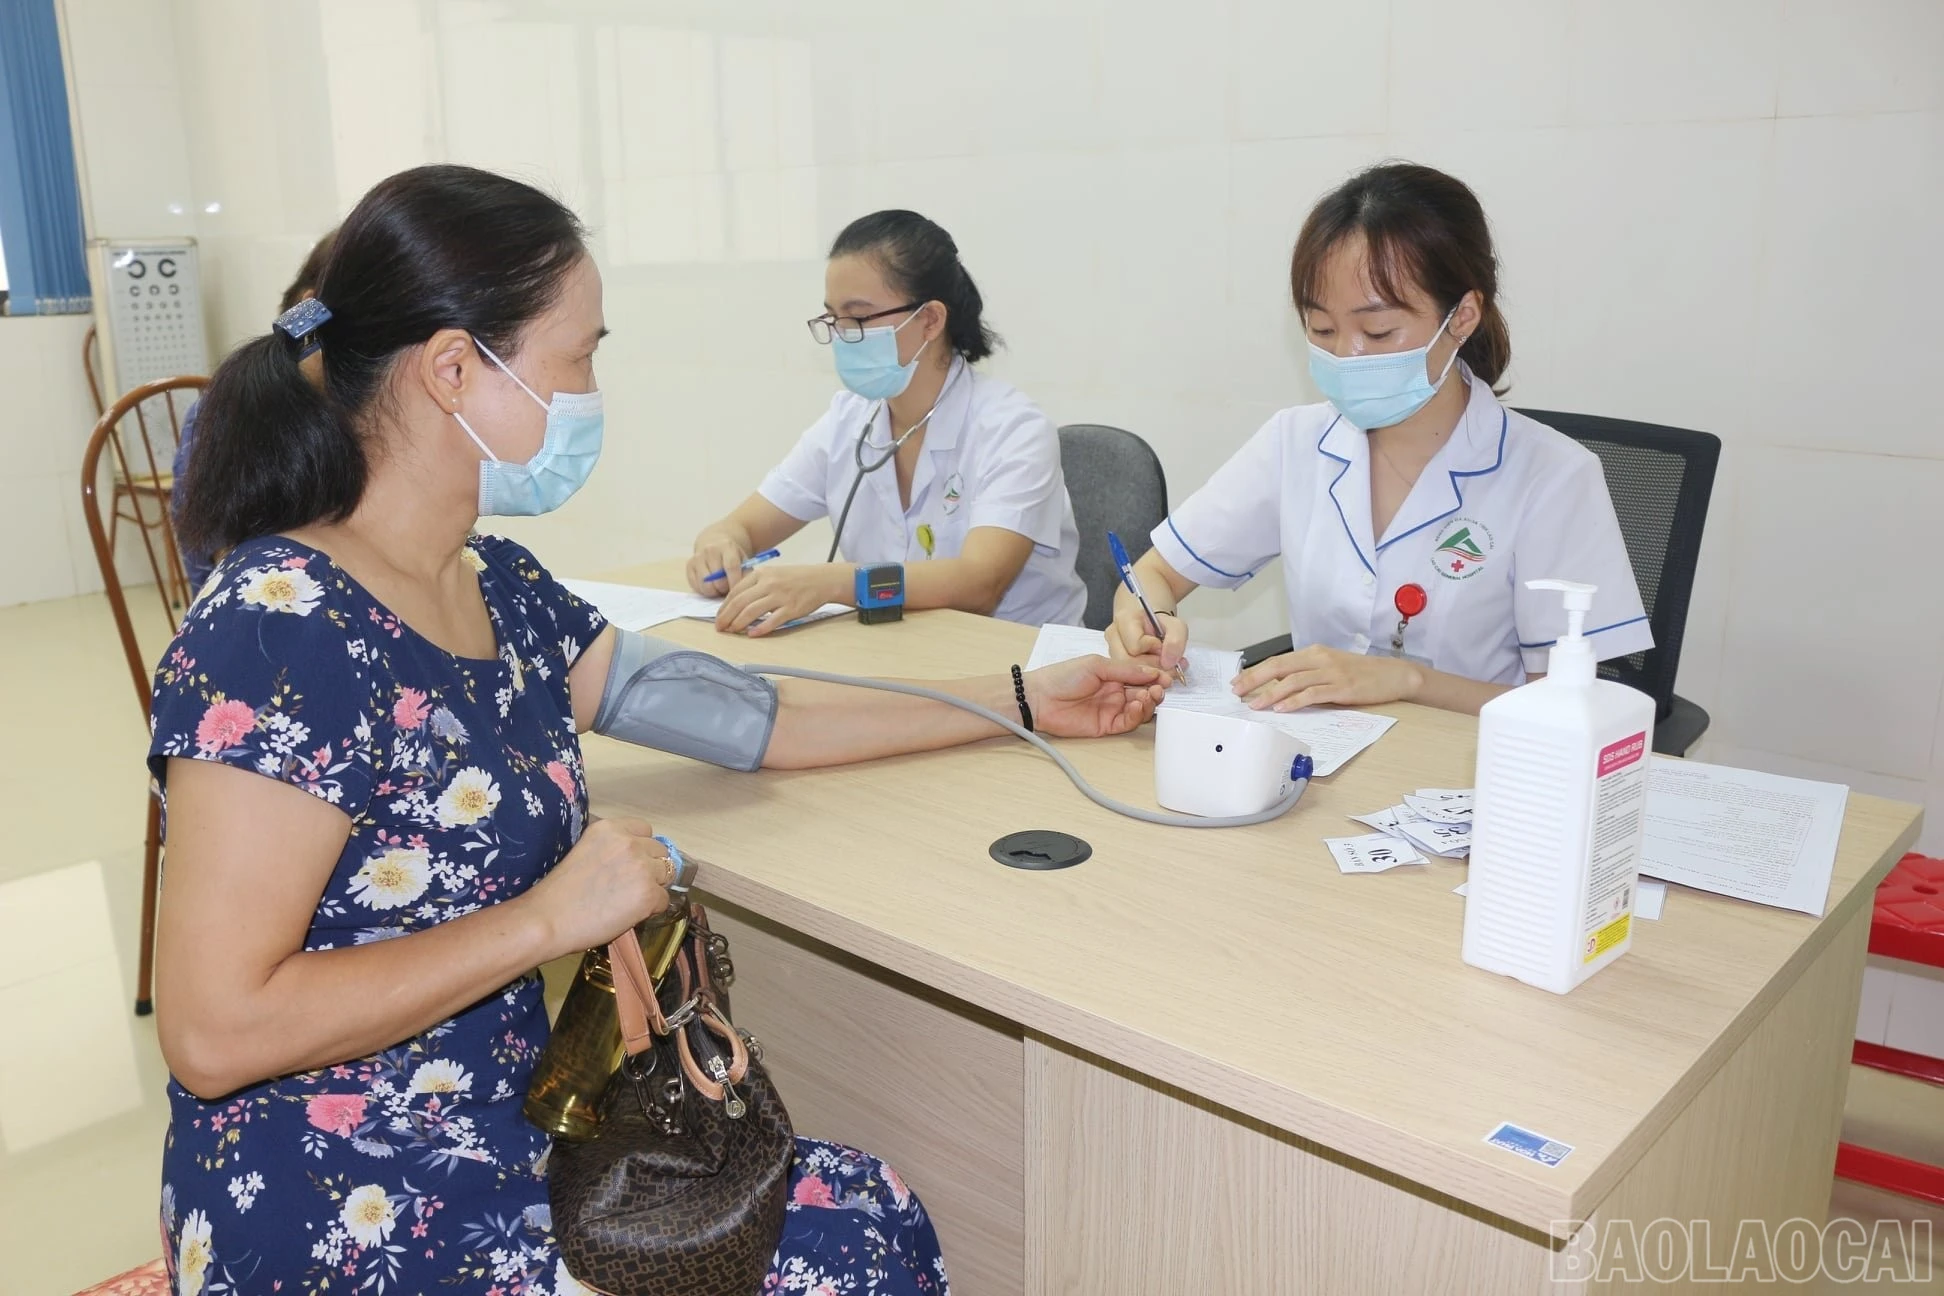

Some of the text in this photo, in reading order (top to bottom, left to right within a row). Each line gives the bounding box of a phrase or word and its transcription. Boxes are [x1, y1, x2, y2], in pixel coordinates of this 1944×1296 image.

[1615, 745, 1631, 760] HAND
[1631, 739, 1643, 752] RUB
[1367, 848, 1398, 863] 30
